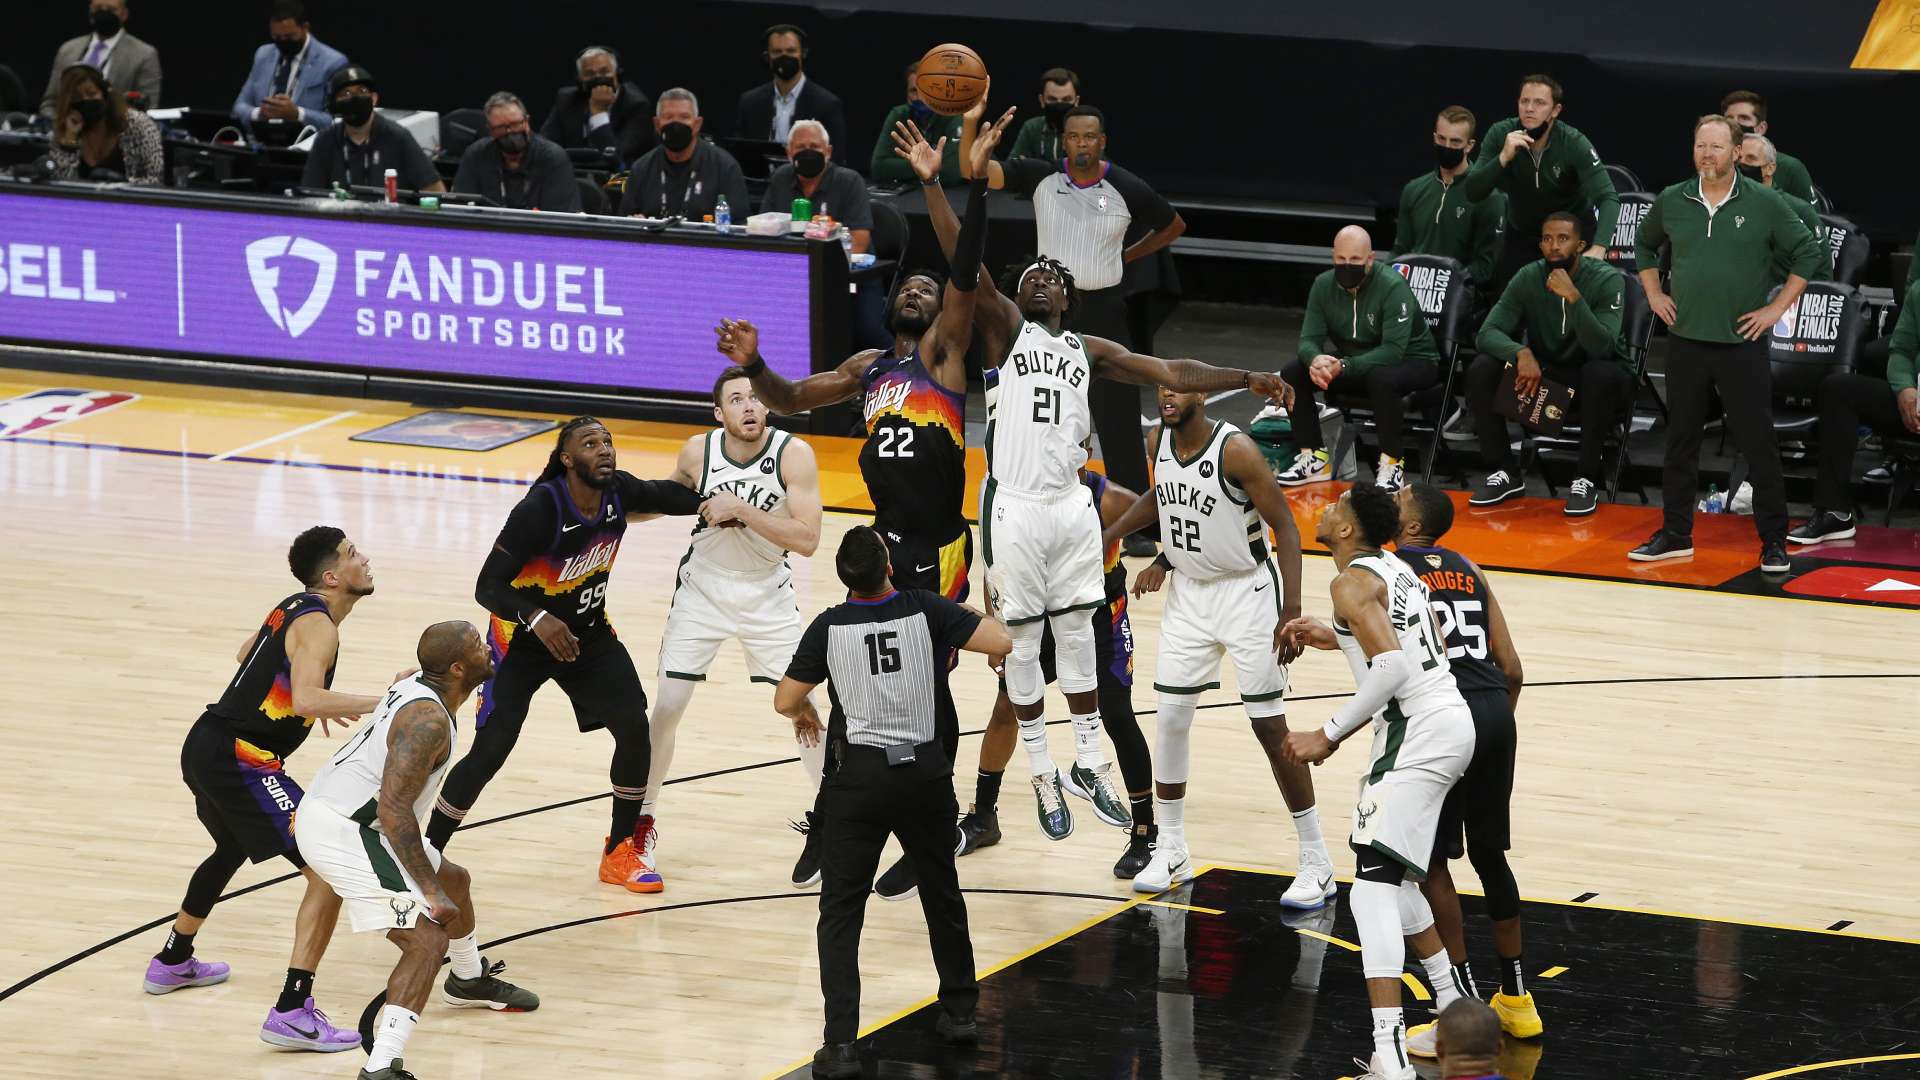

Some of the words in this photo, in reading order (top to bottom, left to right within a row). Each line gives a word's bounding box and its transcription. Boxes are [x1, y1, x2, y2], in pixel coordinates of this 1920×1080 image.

[0, 243, 116, 303] ELL
[354, 249, 625, 316] FANDUEL
[1409, 265, 1436, 290] NBA
[1433, 268, 1452, 293] 2021
[1800, 293, 1828, 317] NBA
[1827, 294, 1845, 318] 2021
[355, 307, 626, 356] SPORTSBOOK
[1796, 316, 1841, 341] FINALS
[1012, 350, 1086, 389] BUCKS
[1032, 386, 1061, 425] 21
[878, 426, 915, 458] 22
[1156, 481, 1217, 517] BUCKS
[1169, 515, 1202, 553] 22
[576, 581, 607, 615] 99
[1420, 570, 1475, 594] RIDGES
[1430, 600, 1488, 660] 25
[864, 631, 902, 676] 15
